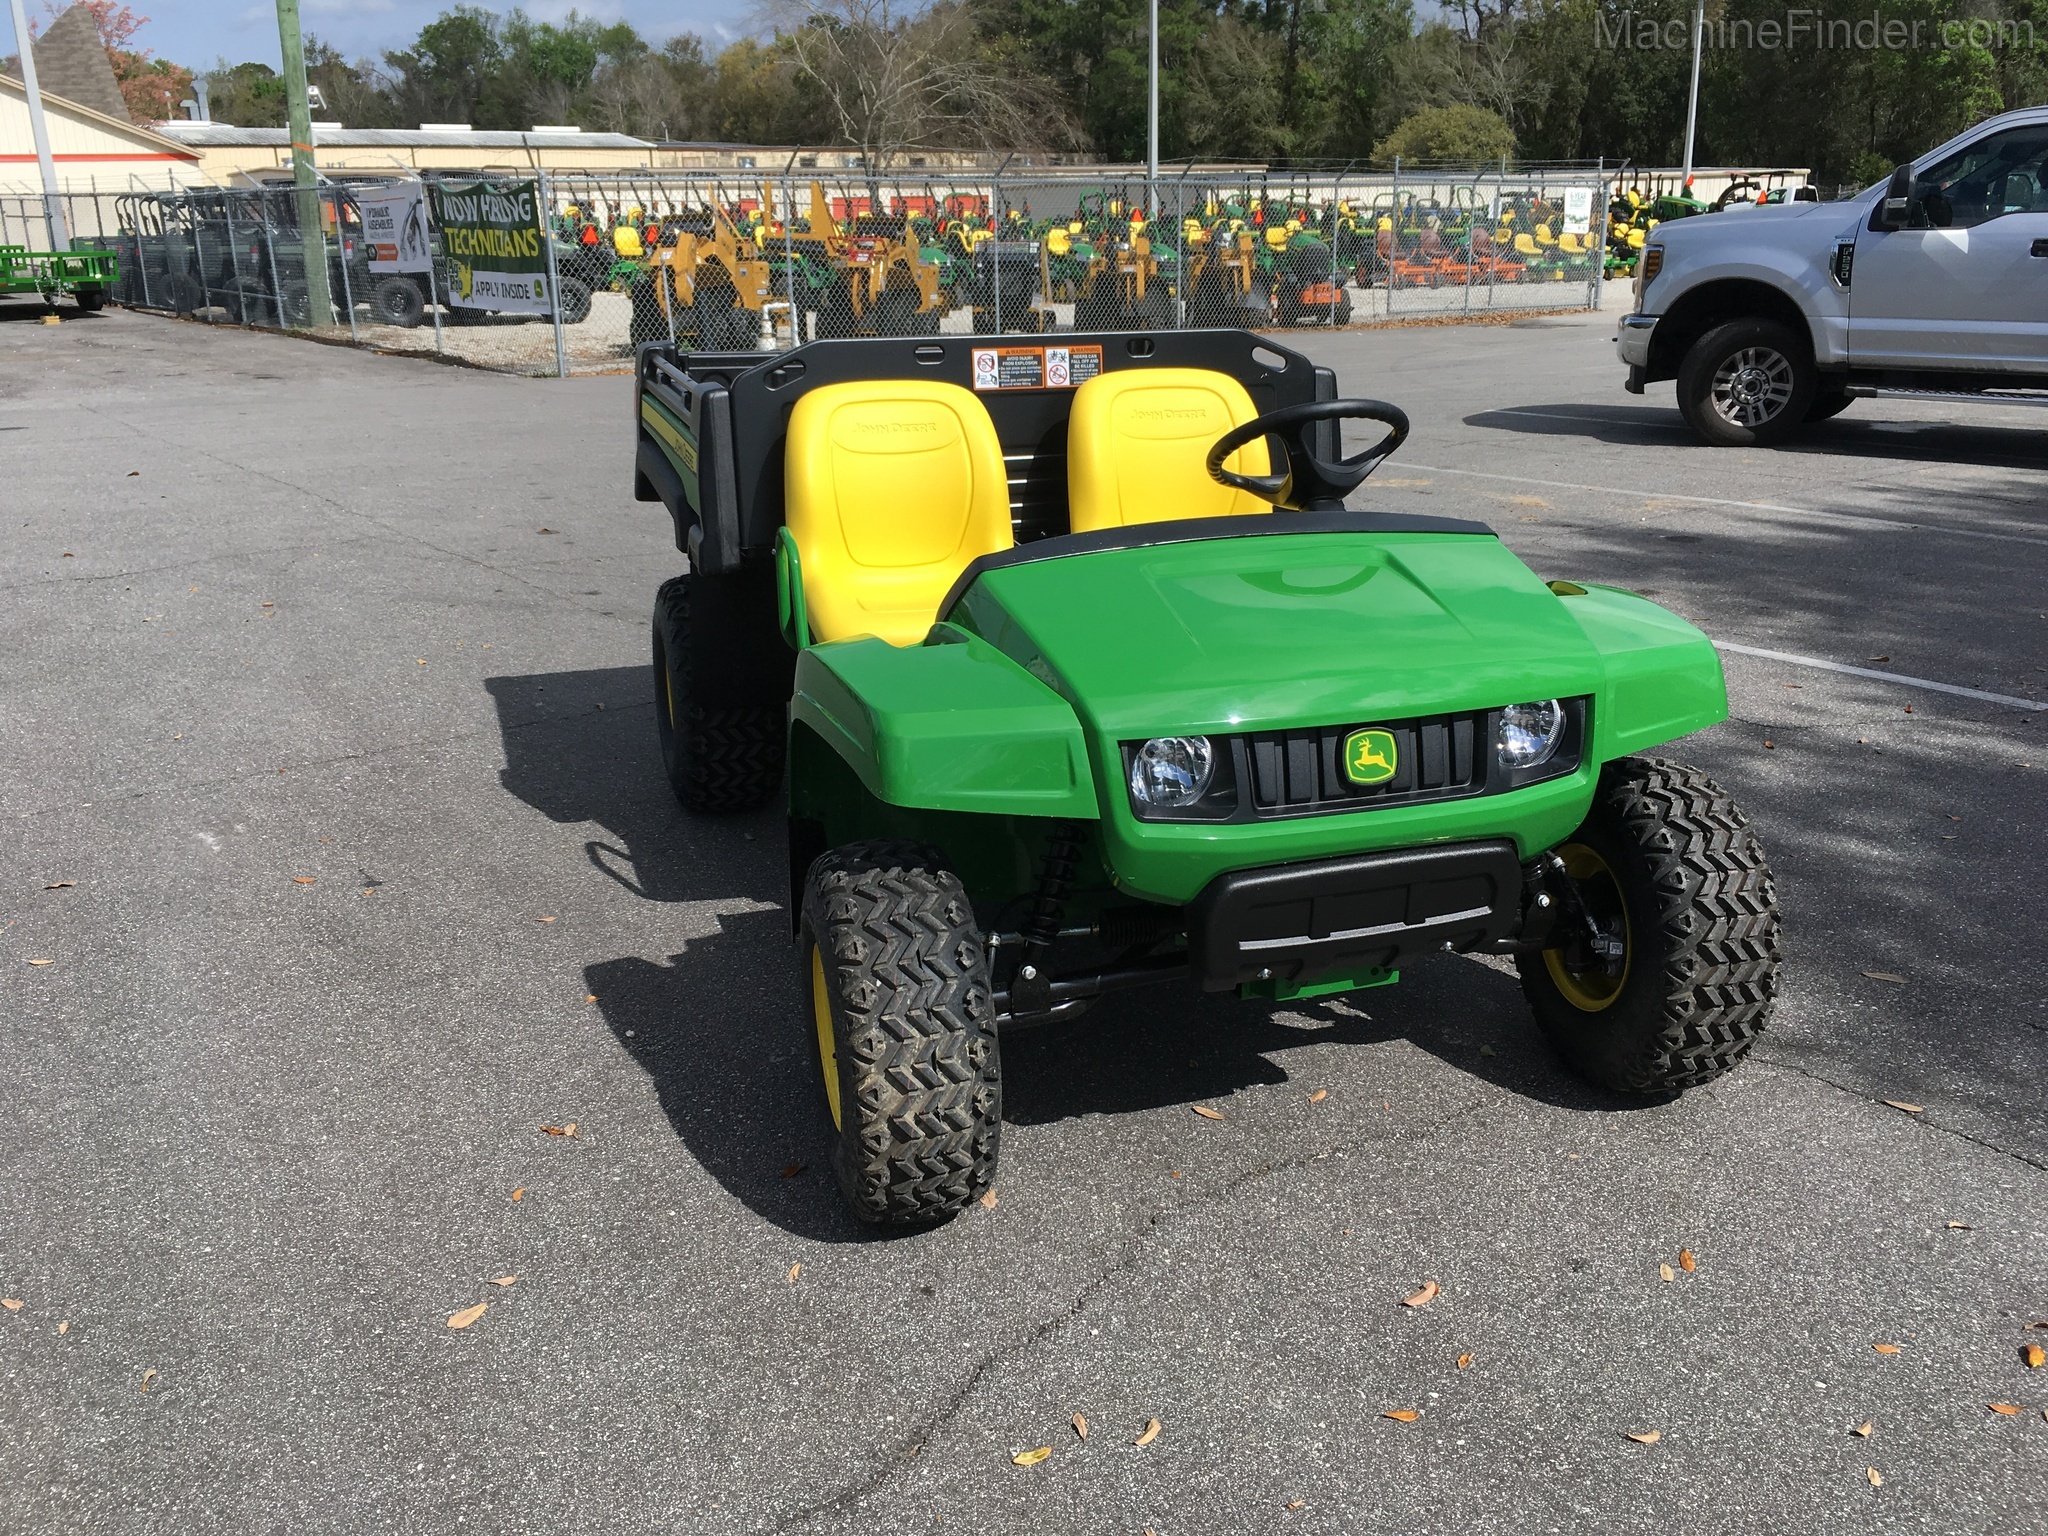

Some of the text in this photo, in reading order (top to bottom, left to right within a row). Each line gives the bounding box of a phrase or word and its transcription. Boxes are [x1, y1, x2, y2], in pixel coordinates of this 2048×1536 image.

[443, 195, 477, 221] NOW
[476, 281, 530, 299] APPLY INSIDE
[1130, 408, 1206, 420] JOHN DEERE
[853, 422, 937, 434] JOHN DEERE
